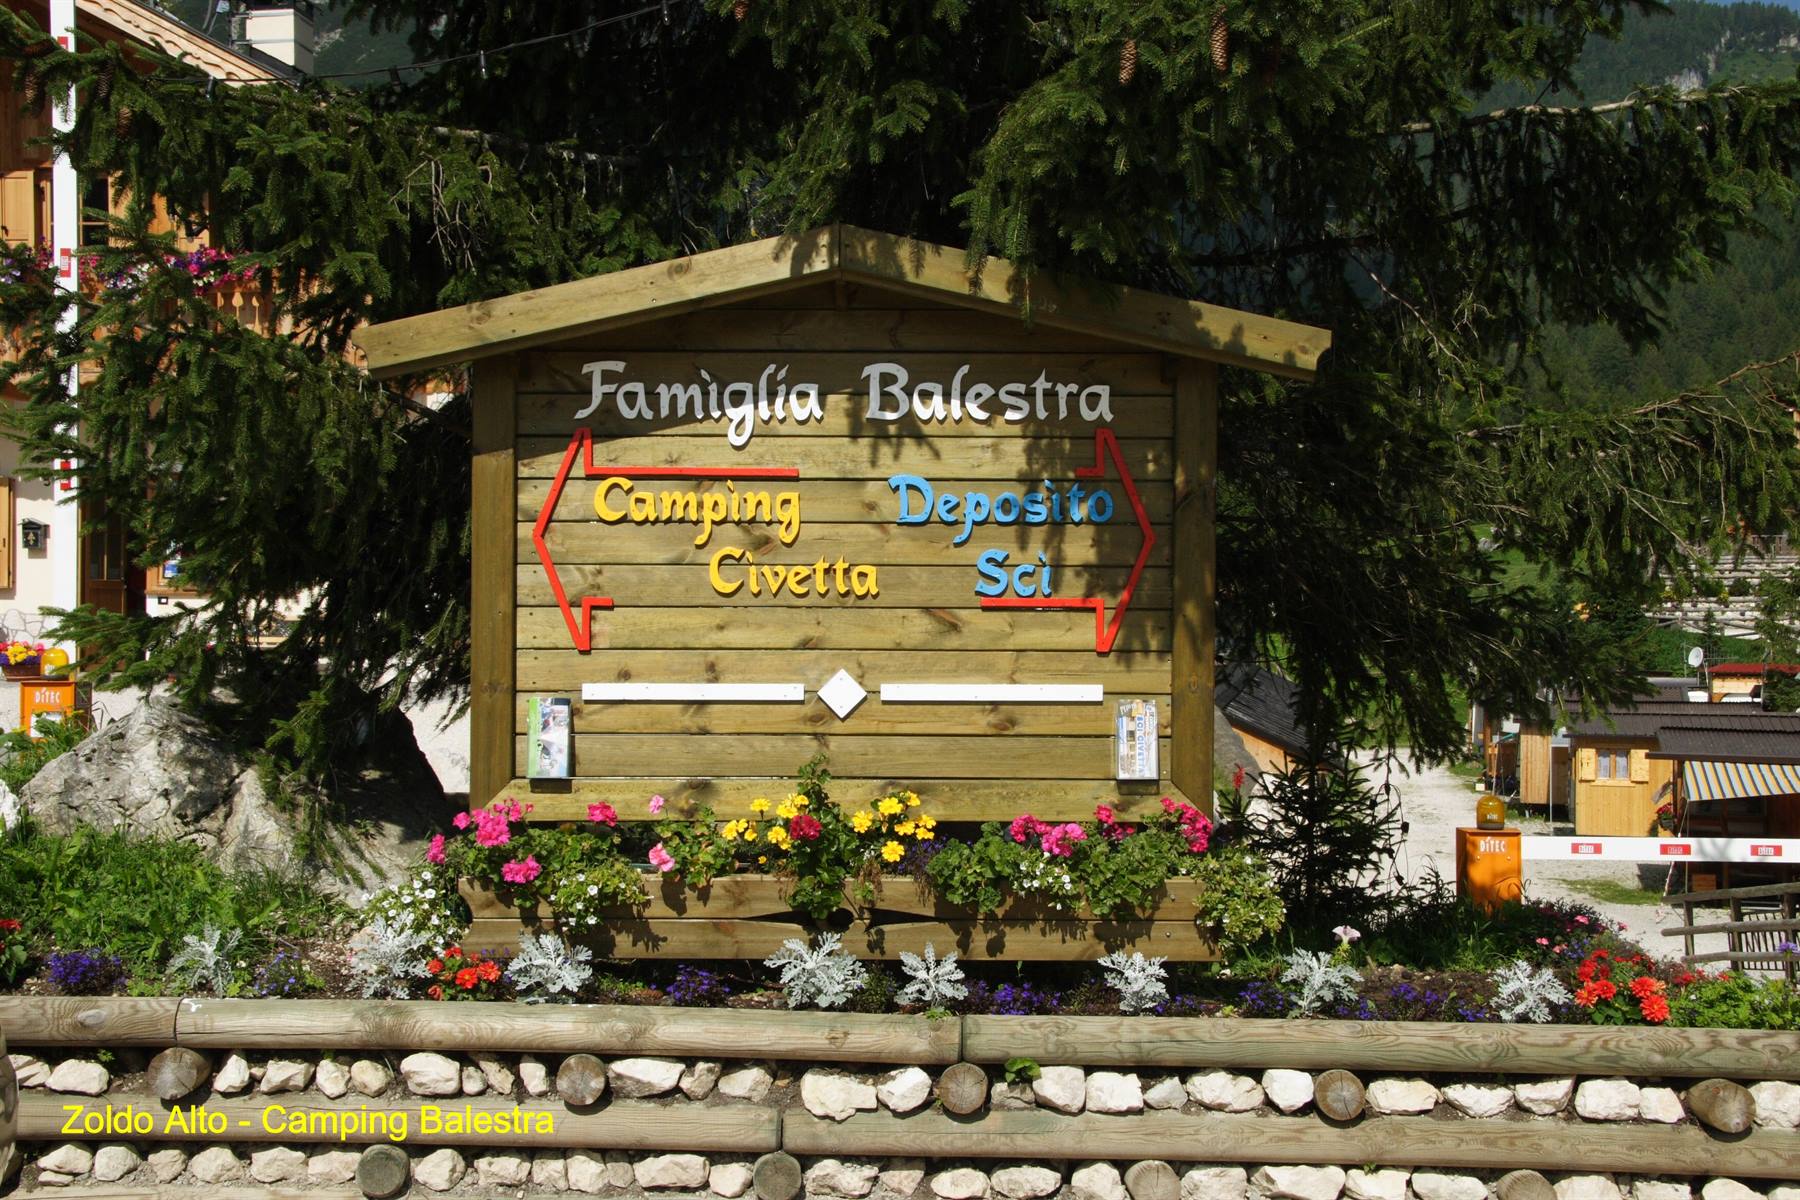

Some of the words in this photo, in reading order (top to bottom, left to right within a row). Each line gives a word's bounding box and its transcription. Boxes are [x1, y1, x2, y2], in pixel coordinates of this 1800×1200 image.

[574, 361, 824, 447] Famiglia
[861, 363, 1114, 423] Balestra
[593, 477, 801, 545] Camping
[888, 475, 1115, 545] Deposito
[709, 547, 880, 597] Civetta
[976, 550, 1053, 597] Sci
